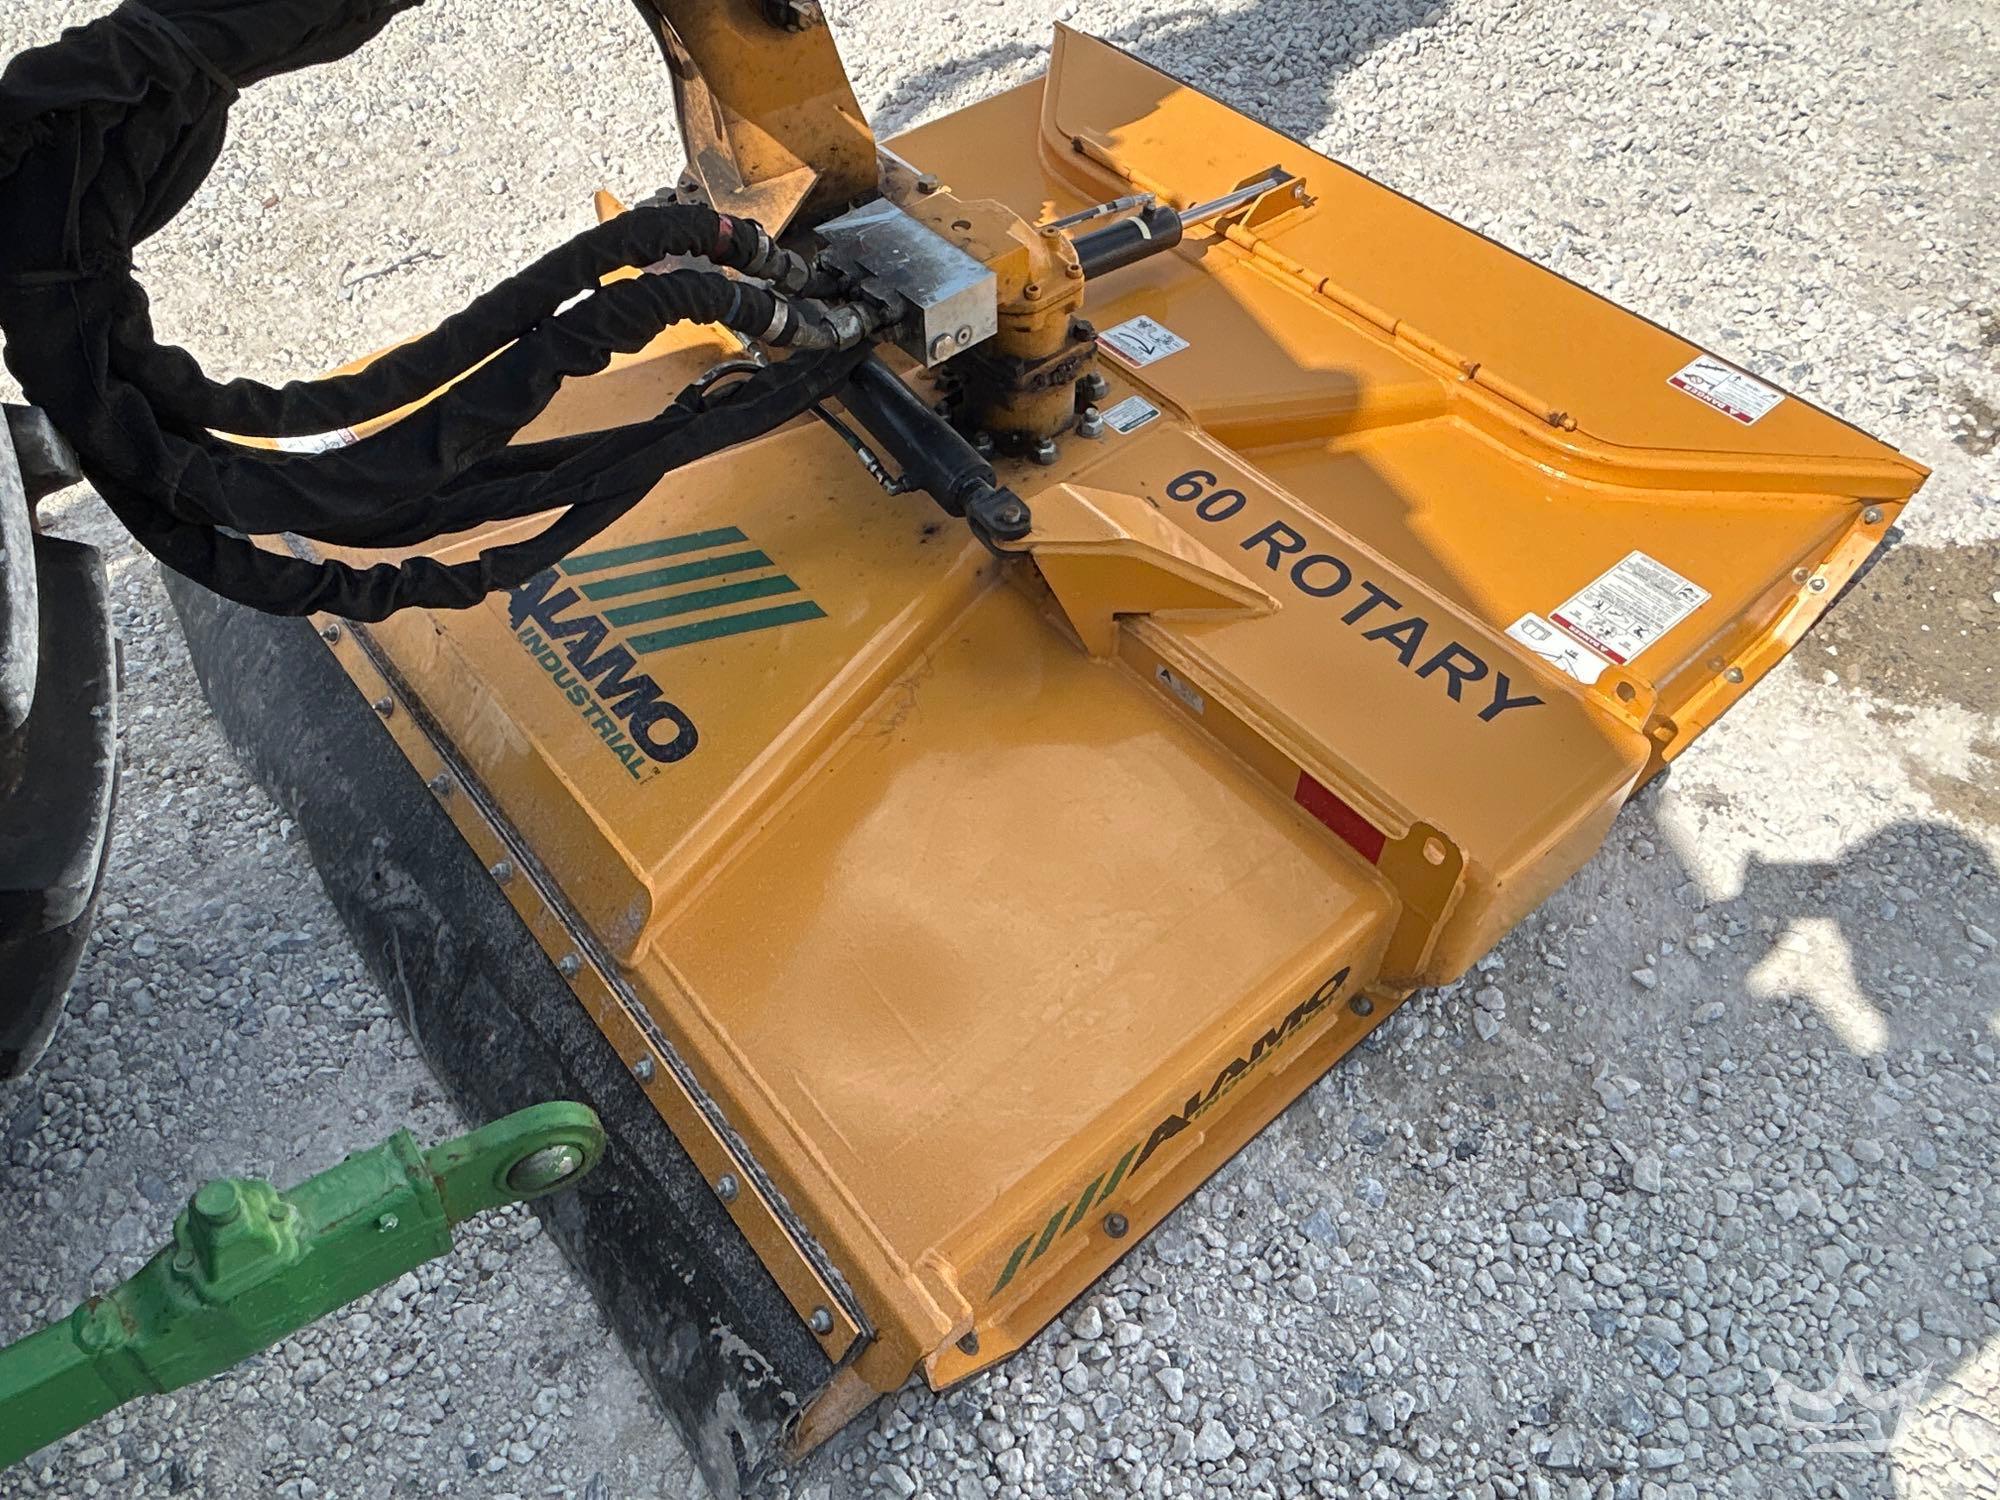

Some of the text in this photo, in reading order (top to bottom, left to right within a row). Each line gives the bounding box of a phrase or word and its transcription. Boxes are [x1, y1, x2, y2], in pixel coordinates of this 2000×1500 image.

[1683, 384, 1726, 410] DANGER
[1166, 470, 1247, 522] 60
[1240, 520, 1546, 722] ROTARY
[1568, 624, 1600, 648] DANGER
[517, 626, 641, 780] INDUSTRIAL
[1128, 966, 1350, 1179] ALAMO
